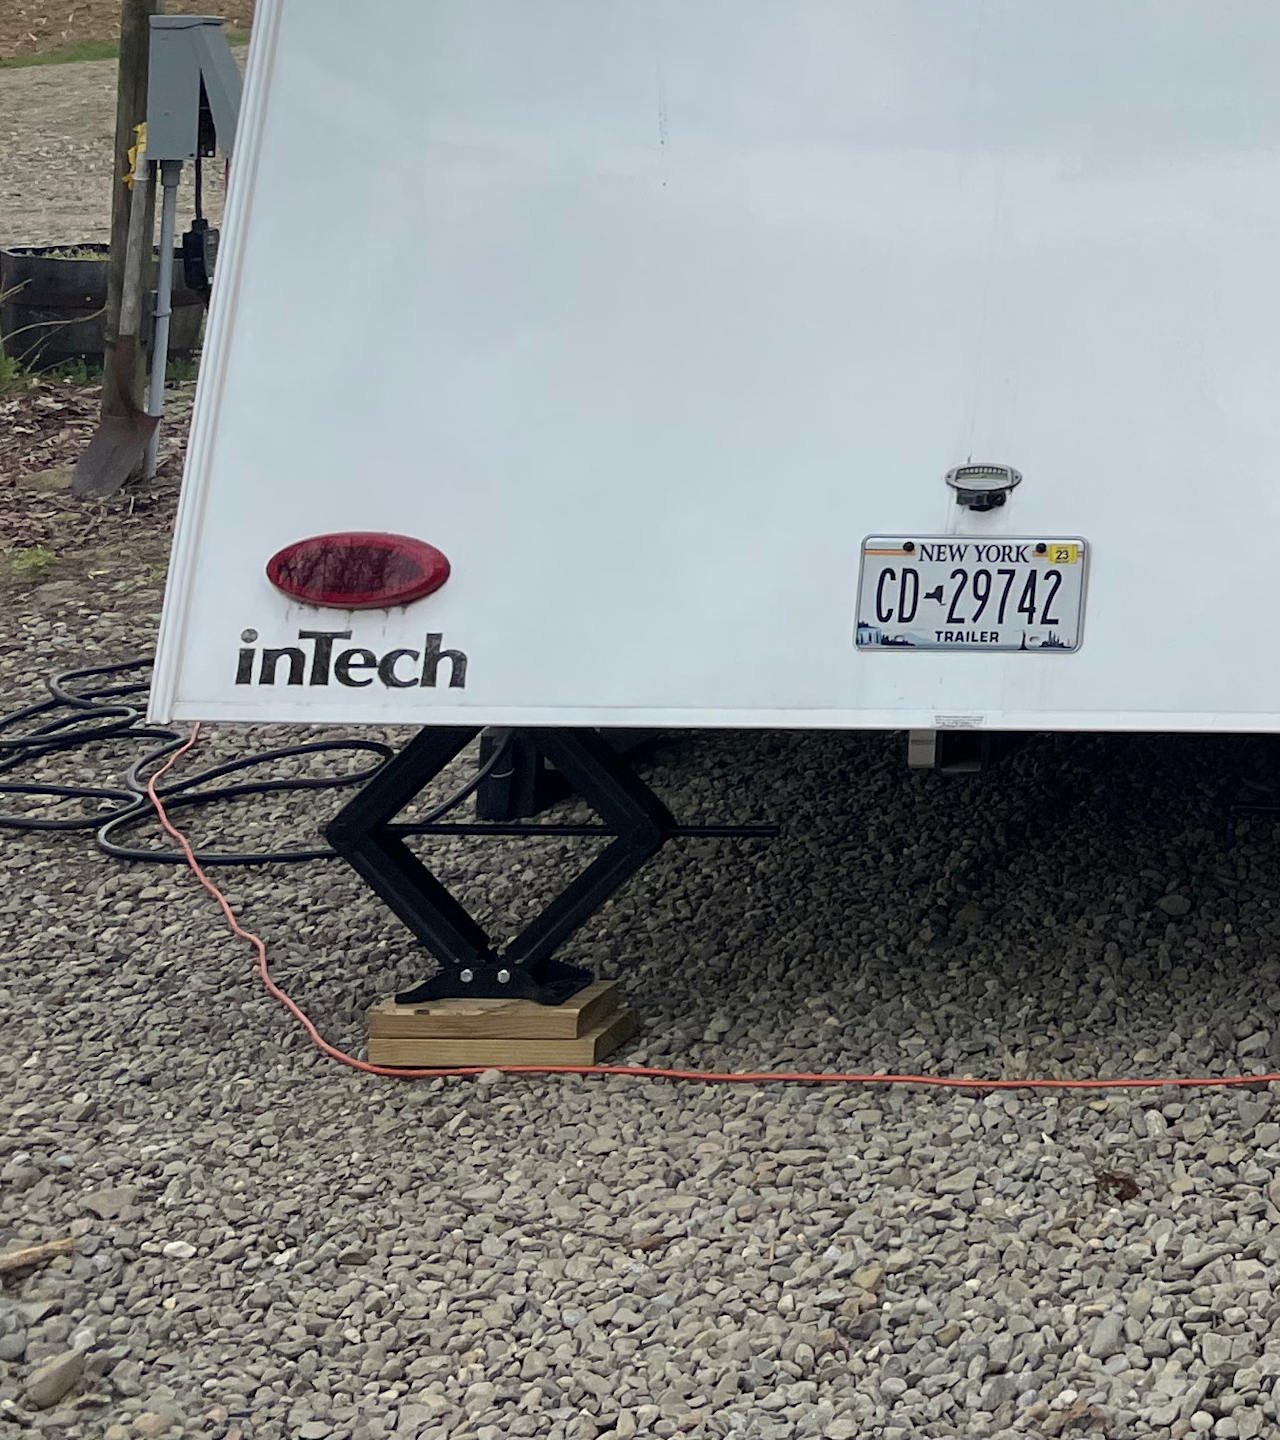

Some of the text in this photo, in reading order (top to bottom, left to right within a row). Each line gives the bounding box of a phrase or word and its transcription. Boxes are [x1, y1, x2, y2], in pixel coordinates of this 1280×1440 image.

[918, 544, 1031, 563] NEW YORK
[1056, 549, 1069, 560] 23
[875, 567, 1063, 625] CD 29742
[935, 630, 999, 643] TRAILER
[235, 628, 468, 688] inTech
